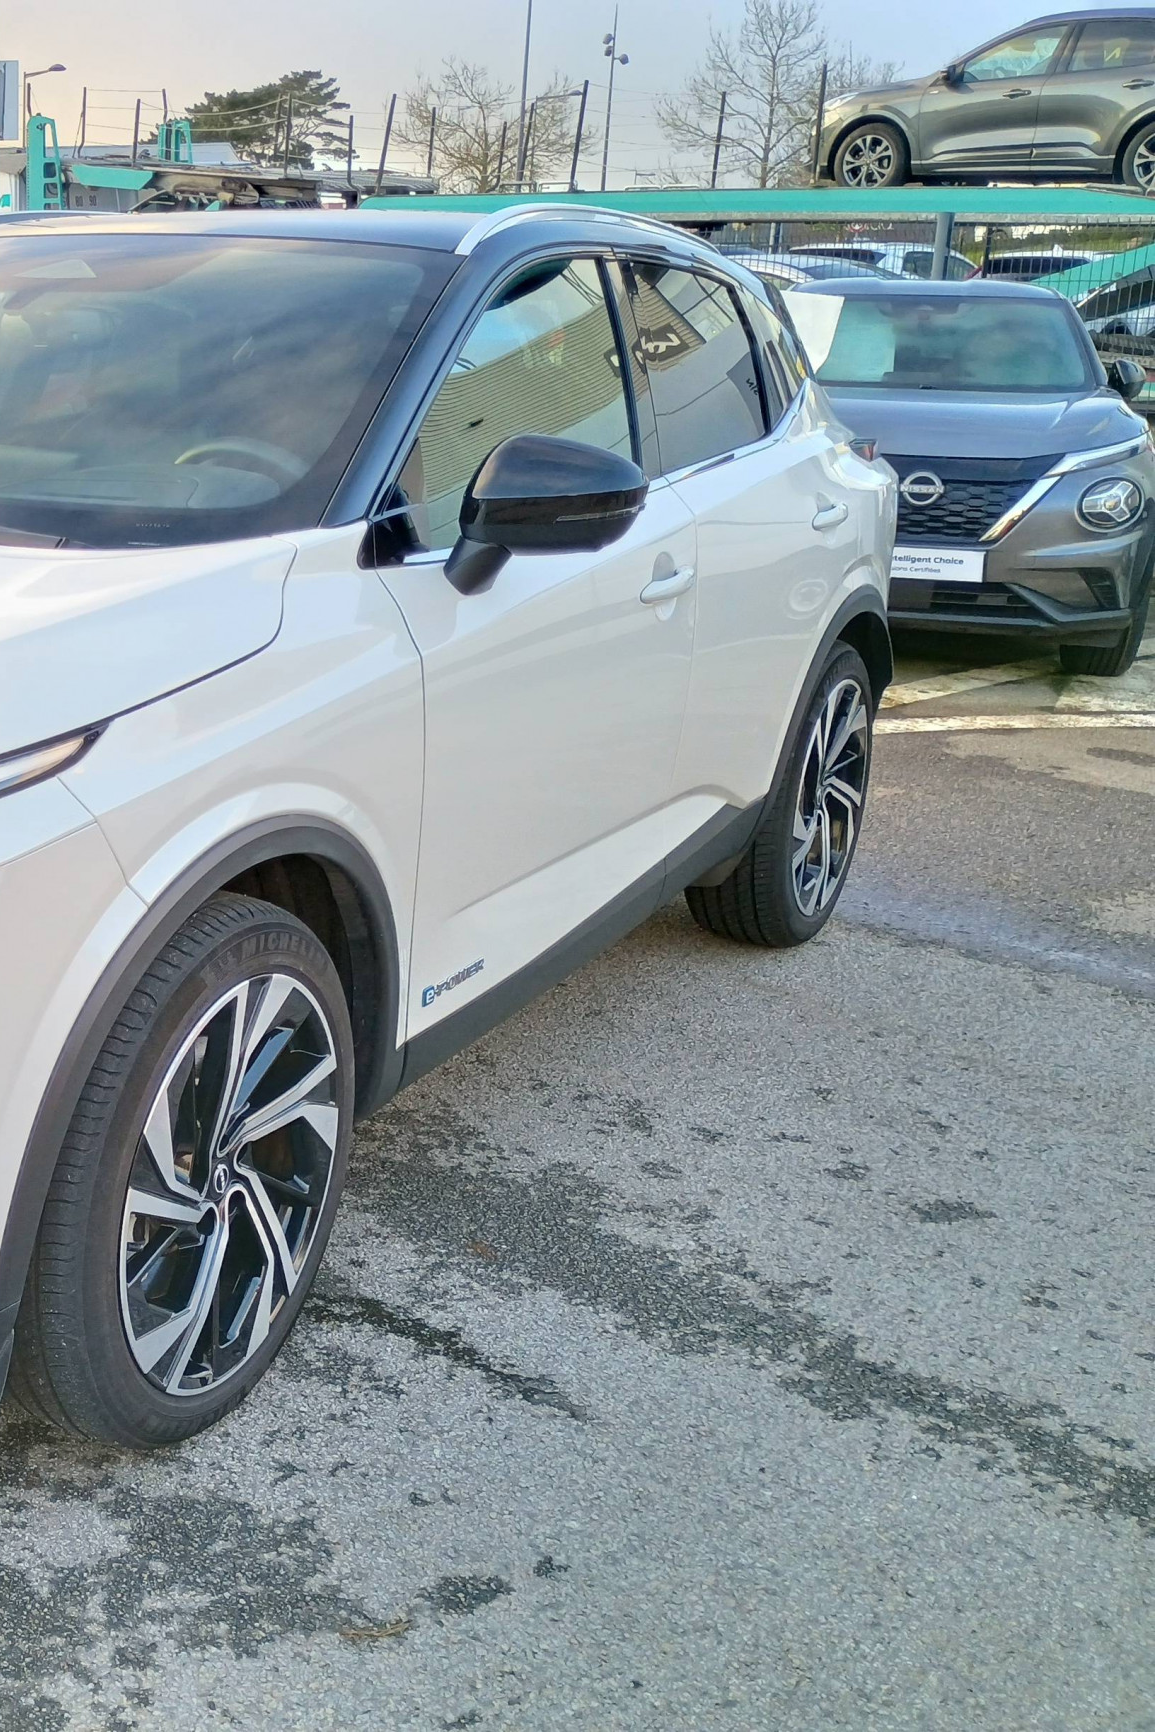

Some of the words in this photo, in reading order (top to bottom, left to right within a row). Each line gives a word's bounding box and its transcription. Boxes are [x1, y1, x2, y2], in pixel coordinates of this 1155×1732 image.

[901, 485, 944, 494] NISSAN
[893, 555, 931, 564] telligent
[933, 557, 964, 565] Choice
